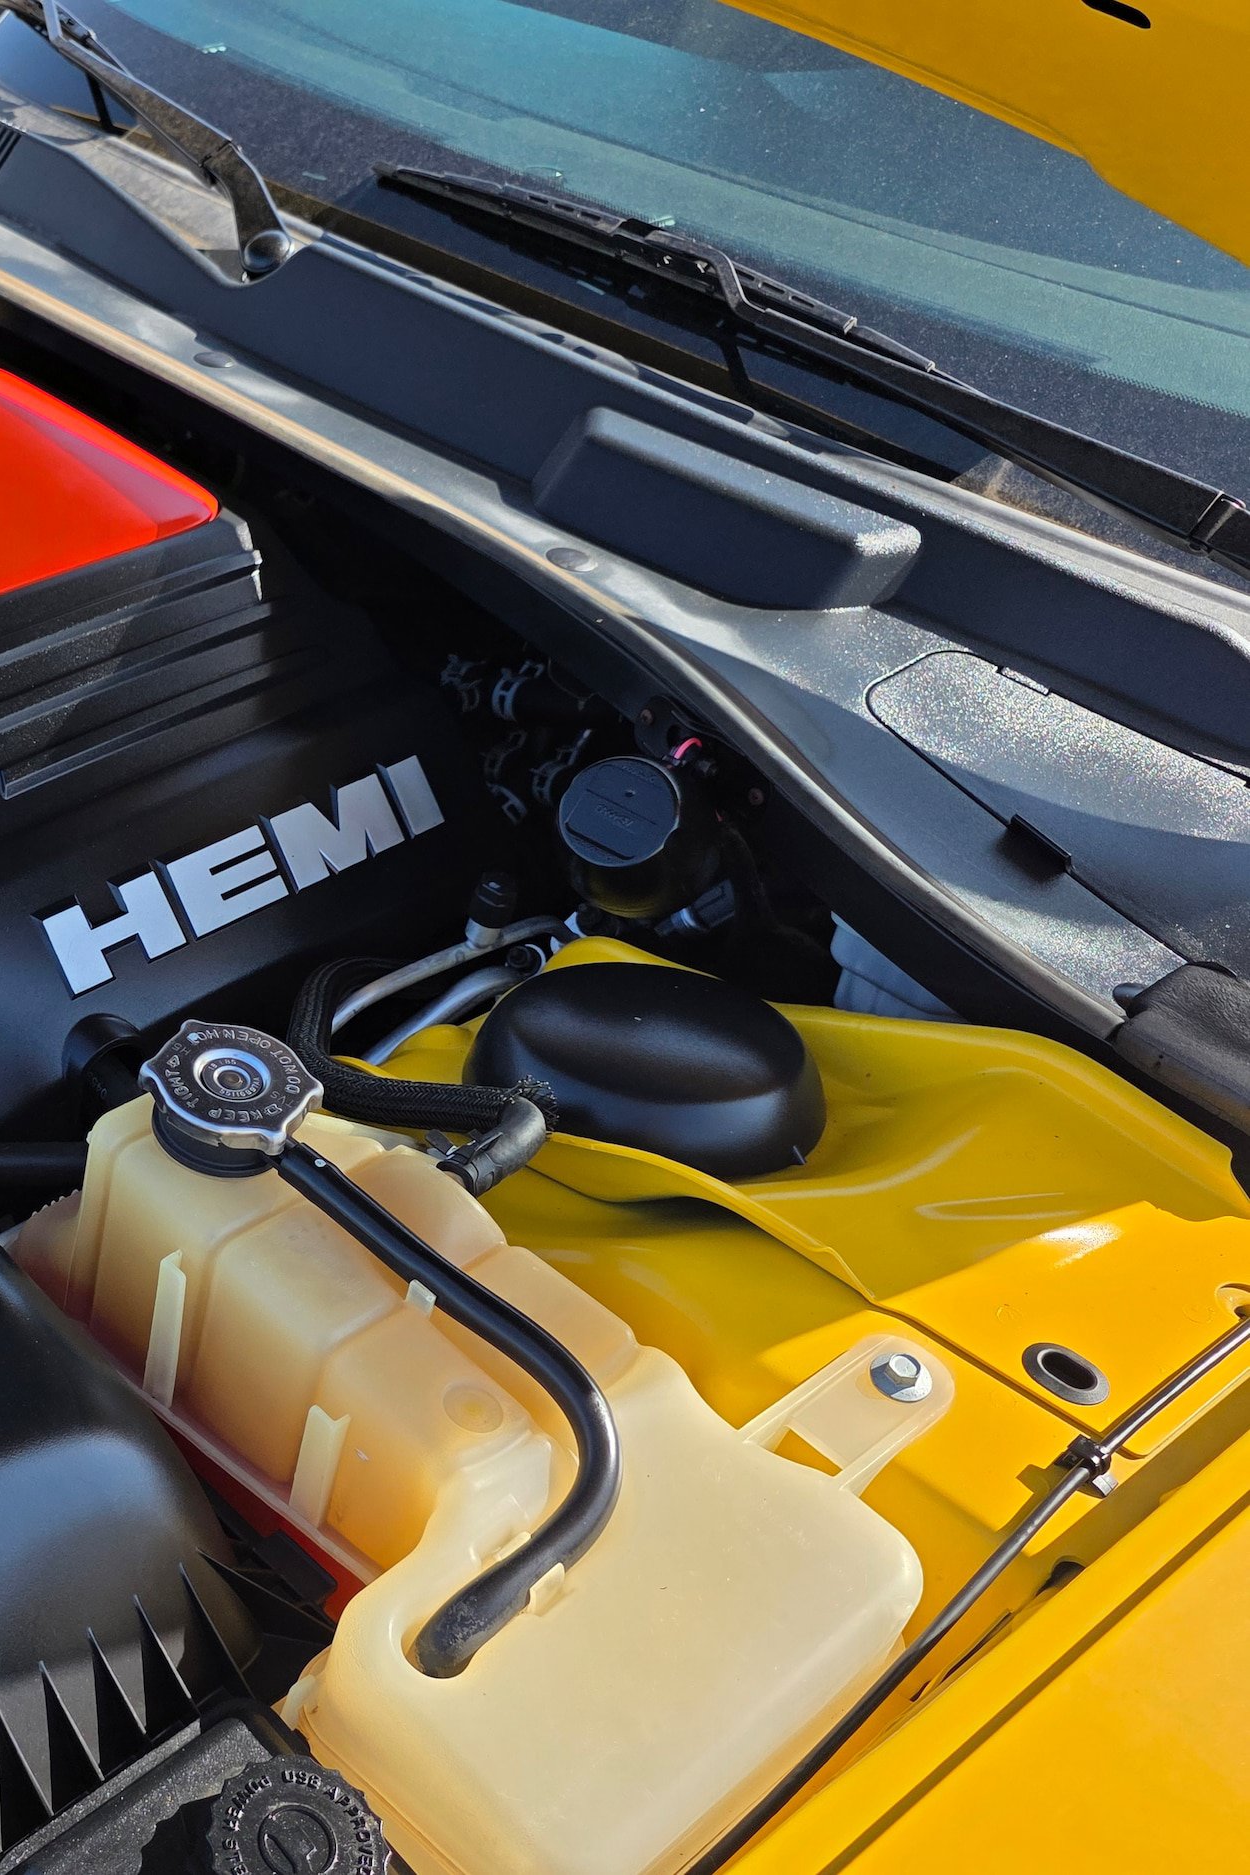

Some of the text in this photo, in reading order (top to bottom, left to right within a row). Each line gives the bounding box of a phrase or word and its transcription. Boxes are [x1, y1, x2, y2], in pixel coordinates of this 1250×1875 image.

[41, 755, 447, 996] HEMI
[223, 1028, 272, 1050] OPEN
[164, 1068, 264, 1122] KEEP TIGHT
[222, 1774, 273, 1832] POWER
[281, 1769, 323, 1789] USE
